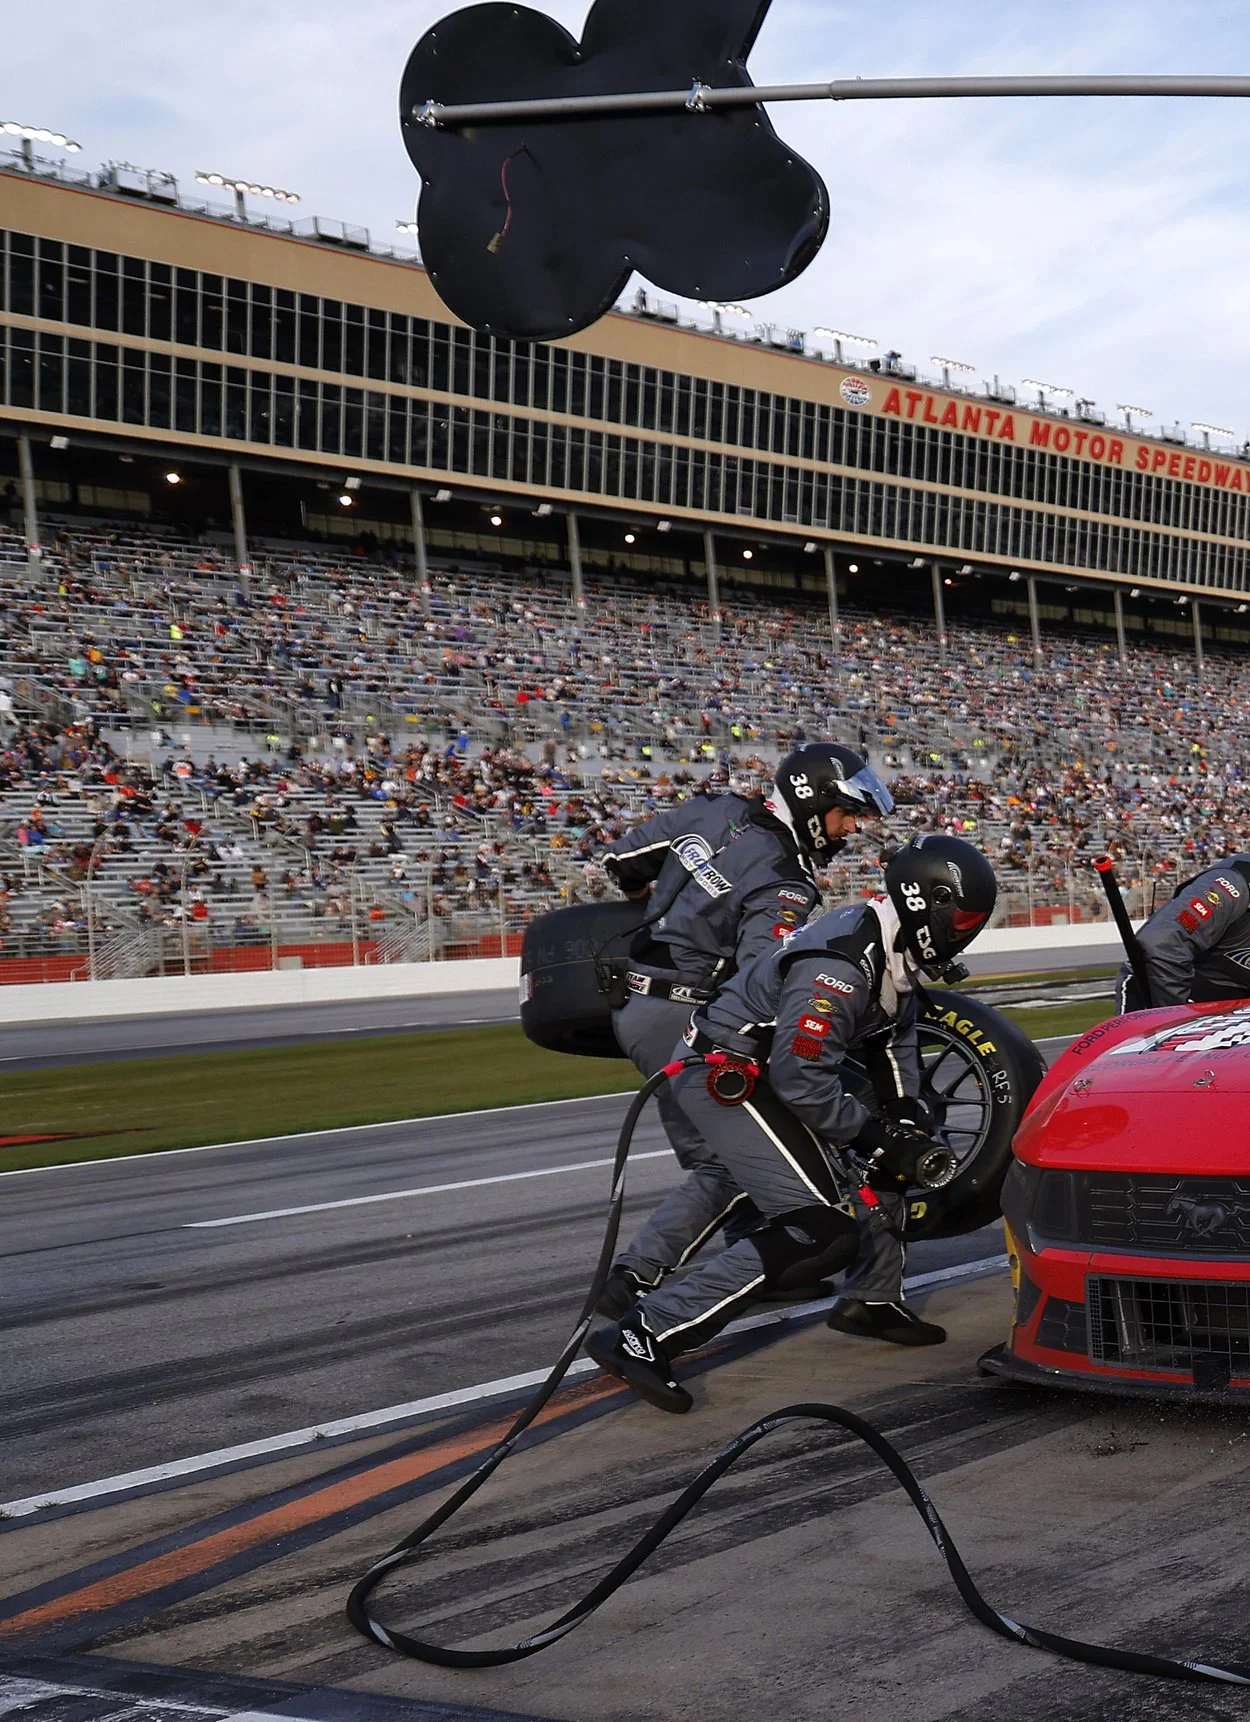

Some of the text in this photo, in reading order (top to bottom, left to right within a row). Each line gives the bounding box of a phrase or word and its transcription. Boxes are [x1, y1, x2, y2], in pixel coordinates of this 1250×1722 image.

[882, 387, 1015, 441] ATLANTA
[1029, 420, 1123, 465] MOTOR
[789, 773, 815, 800] 38
[777, 889, 810, 905] FORD
[901, 882, 927, 912] 38
[1215, 877, 1240, 898] FORD
[815, 973, 855, 994] FORD
[803, 1019, 824, 1032] SEM
[1072, 1028, 1105, 1055] FORD
